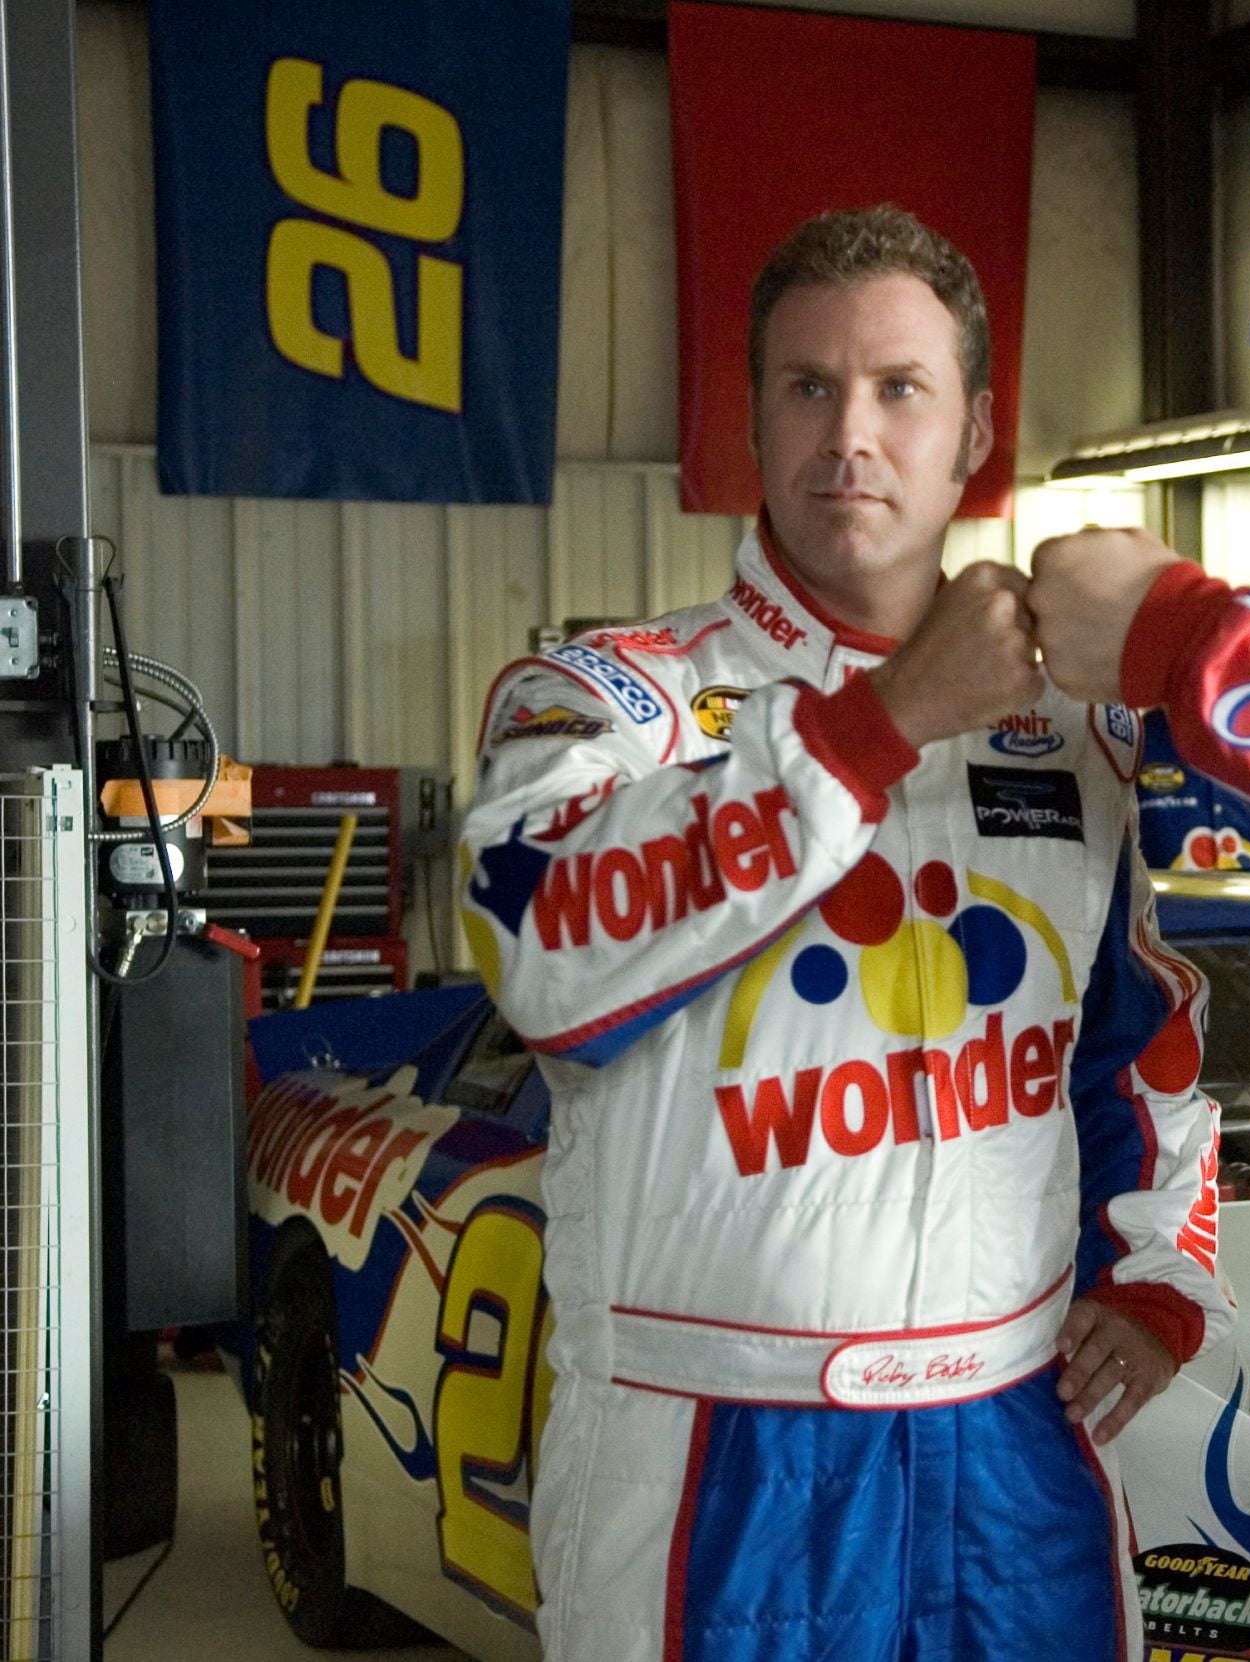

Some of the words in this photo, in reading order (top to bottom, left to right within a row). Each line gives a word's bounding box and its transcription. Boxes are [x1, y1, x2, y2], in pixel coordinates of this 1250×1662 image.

[265, 57, 464, 414] 26
[533, 786, 799, 951] wonder
[715, 1011, 1077, 1178] wonder
[436, 1203, 557, 1612] 2
[1147, 1622, 1219, 1639] BELTS
